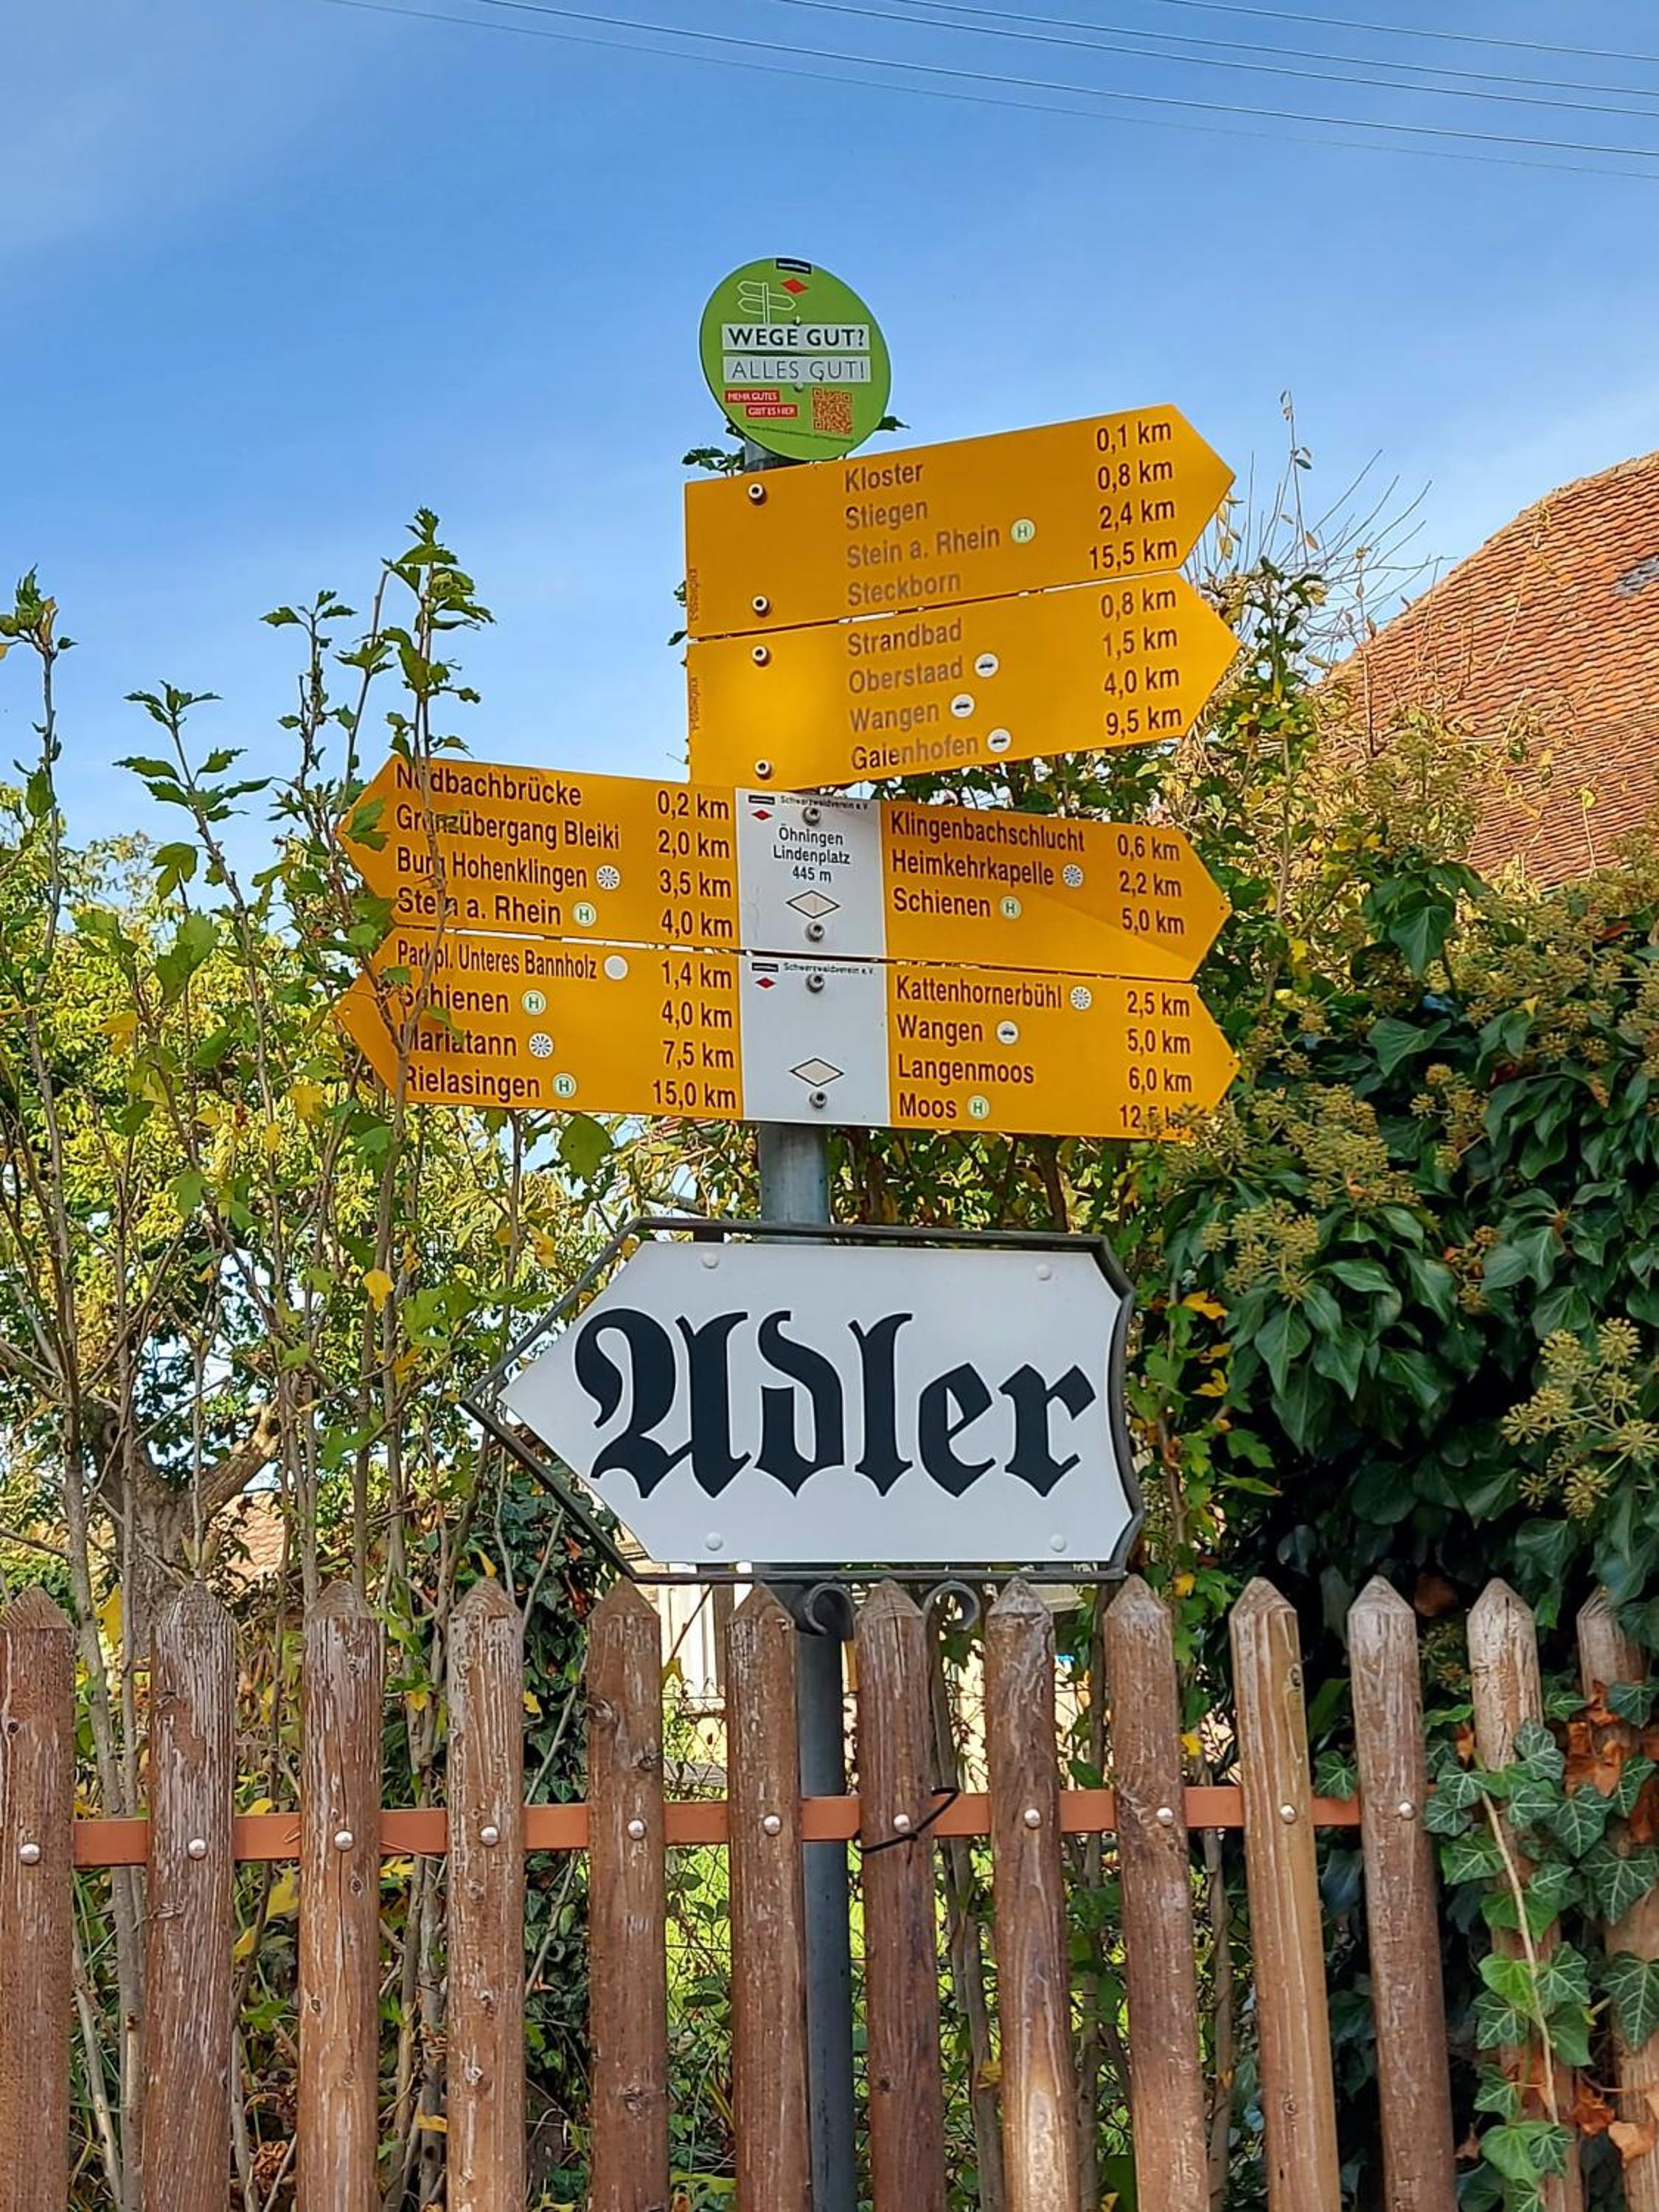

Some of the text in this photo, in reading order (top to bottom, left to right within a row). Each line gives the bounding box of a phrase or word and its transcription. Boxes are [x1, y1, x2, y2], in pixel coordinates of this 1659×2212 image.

[728, 327, 864, 347] WEGE GUT?
[731, 361, 864, 380] ALLES GUT!
[844, 420, 1172, 493] Kloster 0,1 km
[845, 459, 1173, 531] Stiegen 0,8 km
[846, 540, 902, 569] Stein
[909, 540, 929, 560] a.
[936, 524, 1000, 554] Rhein
[1099, 503, 1133, 532] 2,4
[1141, 498, 1175, 524] km
[847, 538, 1178, 607] Steckborn 15,5 km
[847, 588, 1176, 656] Strandbad 0,8 km
[849, 627, 1178, 694] Oberstaad 1,5 km
[849, 666, 1179, 732] Wangen 4,0 km
[851, 706, 1182, 773] Gaienhofen 9,5 km
[658, 790, 689, 817] 0,2
[697, 793, 729, 821] km
[564, 822, 619, 849] Bleiki
[658, 830, 689, 857] 2,0
[698, 832, 730, 859] km
[773, 846, 850, 866] Lindenplatz
[779, 823, 844, 848] Öhningen
[891, 810, 1180, 861] Klingenbachschlucht 0,6 km
[453, 851, 587, 892] Hohenklingen
[660, 869, 691, 897] 3,5
[698, 872, 731, 898] km
[793, 865, 832, 883] 445 m
[891, 849, 1182, 897] Heimkehrkapelle 2,2 km
[397, 886, 458, 918] Sten
[467, 899, 486, 919] a.
[495, 898, 561, 925] Rhein
[661, 908, 693, 937] 4,0
[700, 911, 733, 939] km
[893, 887, 991, 918] Schienen
[1122, 908, 1150, 935] 5,0
[1155, 910, 1184, 935] km
[397, 939, 732, 990] Parkpl. Unteres Bannholz 1,4 km
[661, 1000, 693, 1029] 4,0
[700, 1002, 732, 1029] km
[897, 974, 1190, 1019] Kattenhornerbühl 2,5 km
[663, 1040, 695, 1068] 7,5
[702, 1042, 734, 1069] km
[897, 1014, 1191, 1056] Wangen 5,0 km
[407, 1064, 540, 1103] Rielasingen
[653, 1079, 697, 1109] 15,0
[704, 1082, 736, 1110] km
[898, 1053, 1192, 1094] Langenmoos 6,0 km
[900, 1092, 957, 1119] Moos
[575, 1307, 1096, 1499] Adler
